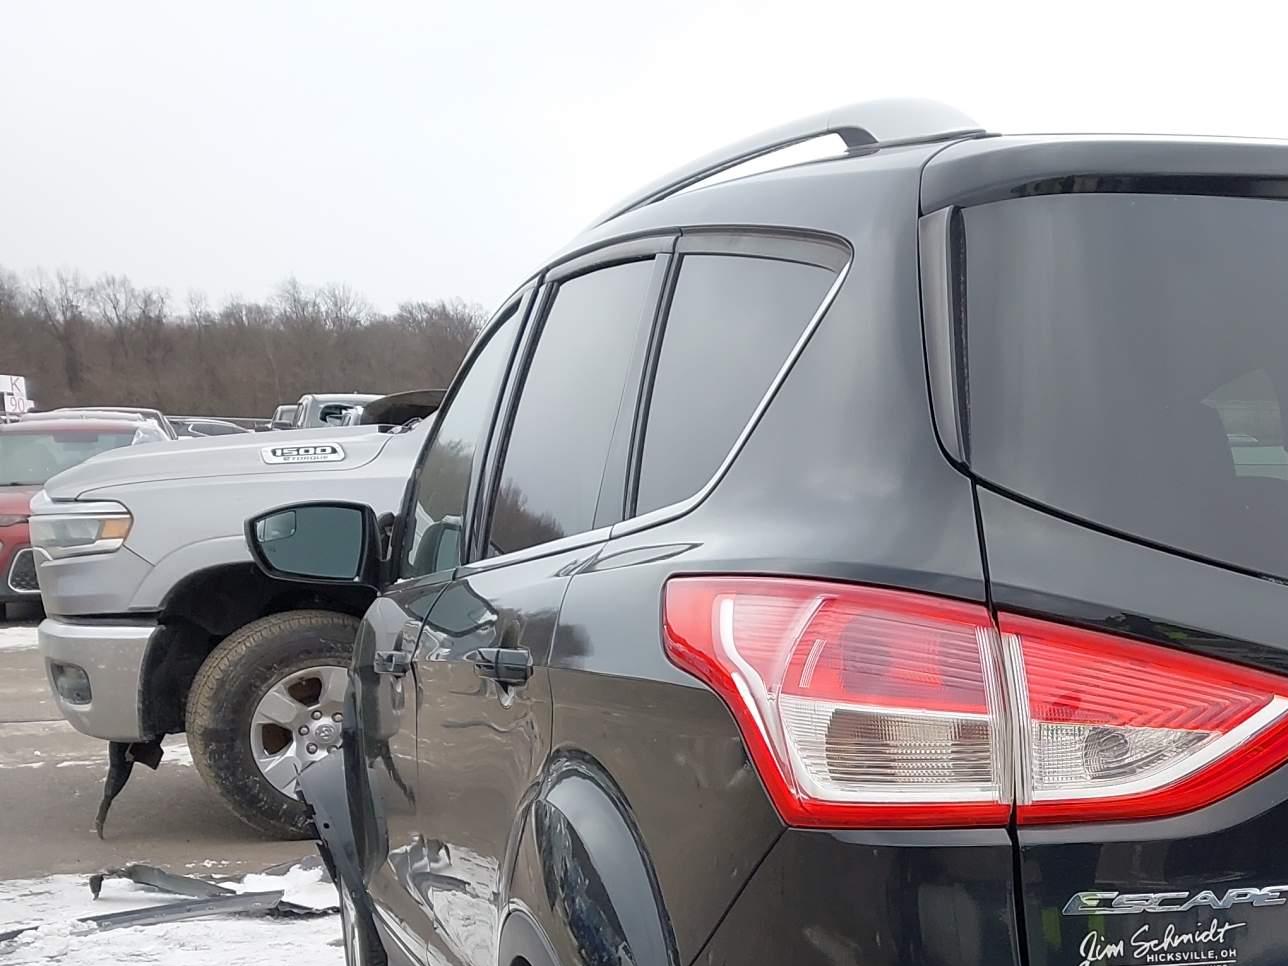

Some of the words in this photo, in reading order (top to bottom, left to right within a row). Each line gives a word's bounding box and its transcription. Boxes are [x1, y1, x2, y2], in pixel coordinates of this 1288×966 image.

[10, 376, 22, 393] K
[271, 445, 336, 457] 1500
[1130, 918, 1248, 959] Schmidt
[1146, 951, 1218, 963] HICKSVILLE,
[1220, 949, 1237, 958] OH
